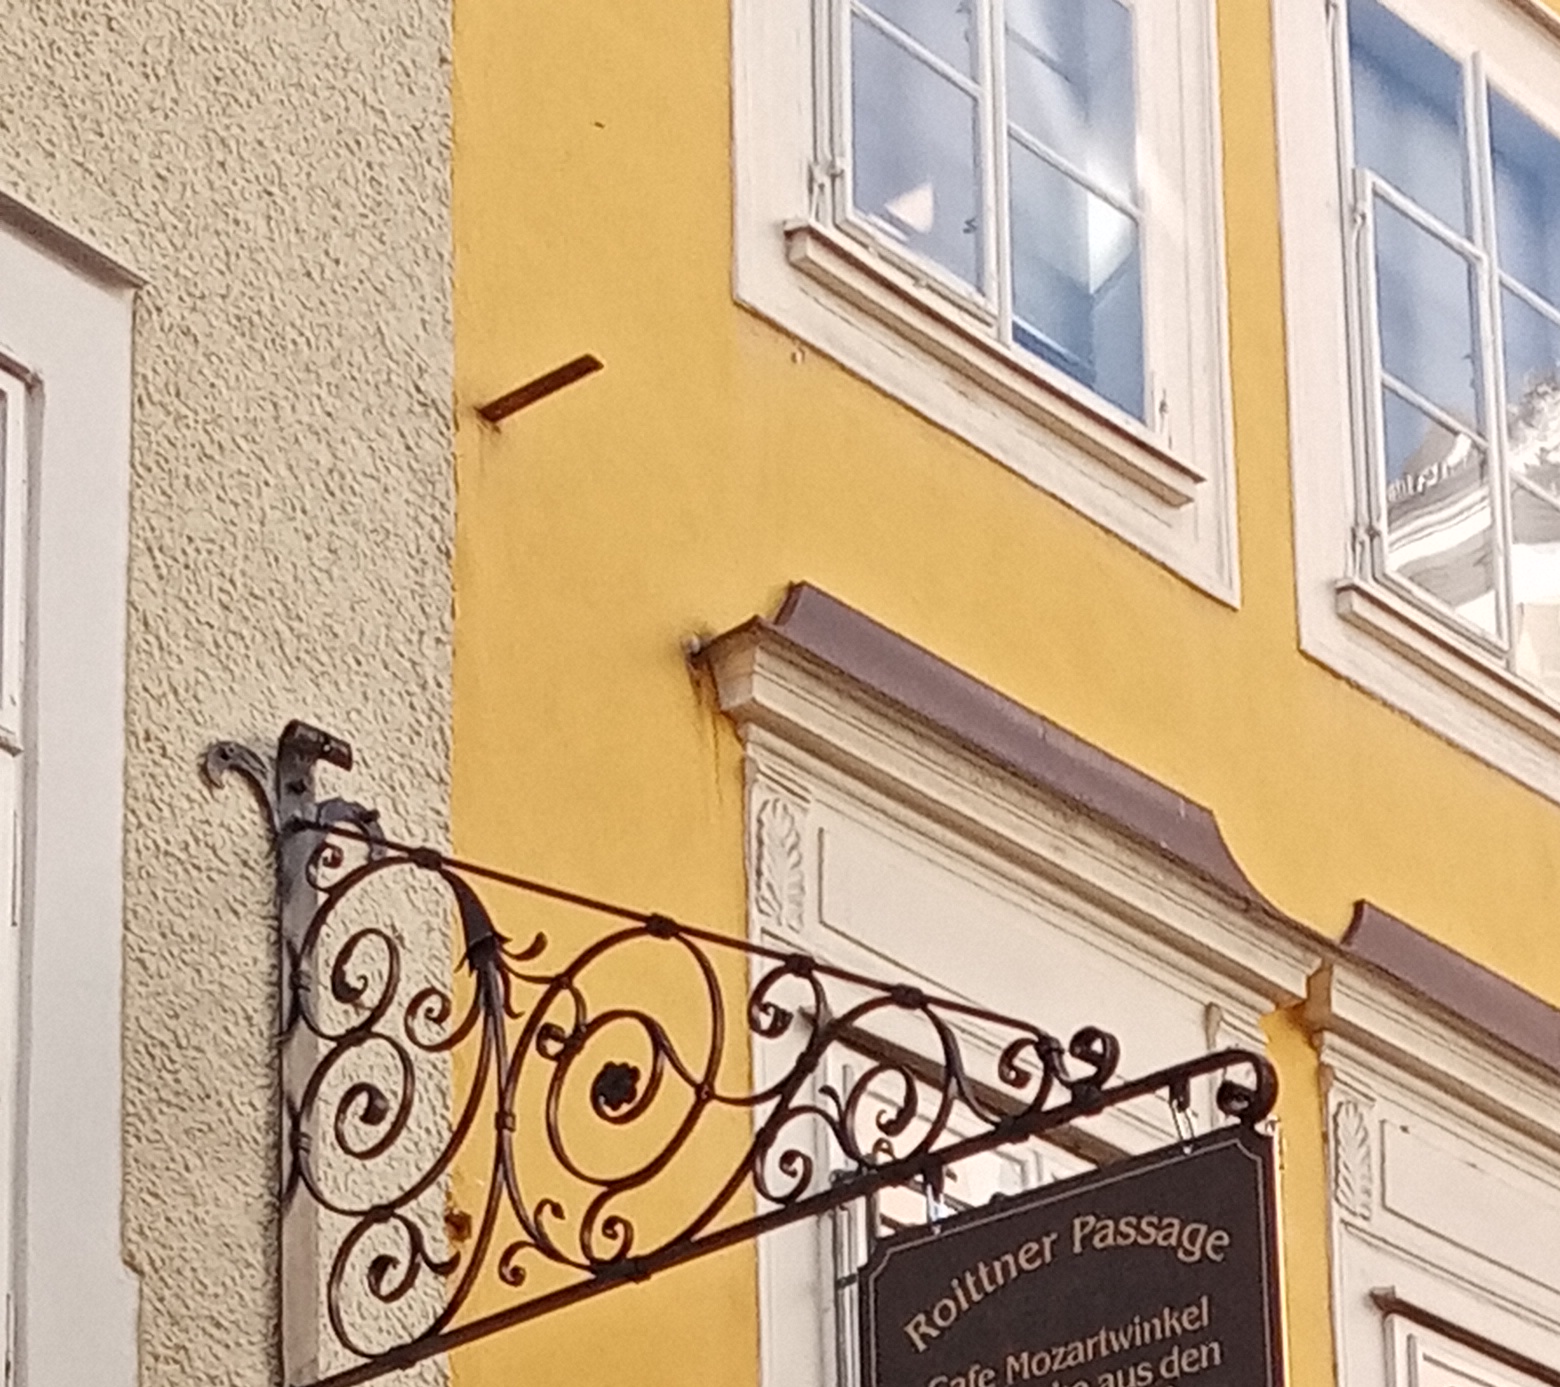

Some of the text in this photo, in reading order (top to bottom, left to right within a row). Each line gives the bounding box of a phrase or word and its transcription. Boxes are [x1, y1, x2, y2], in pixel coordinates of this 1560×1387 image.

[903, 1213, 1231, 1353] Roittner Passage
[1004, 1295, 1210, 1386] Mozartwinkel
[1159, 1340, 1222, 1380] den
